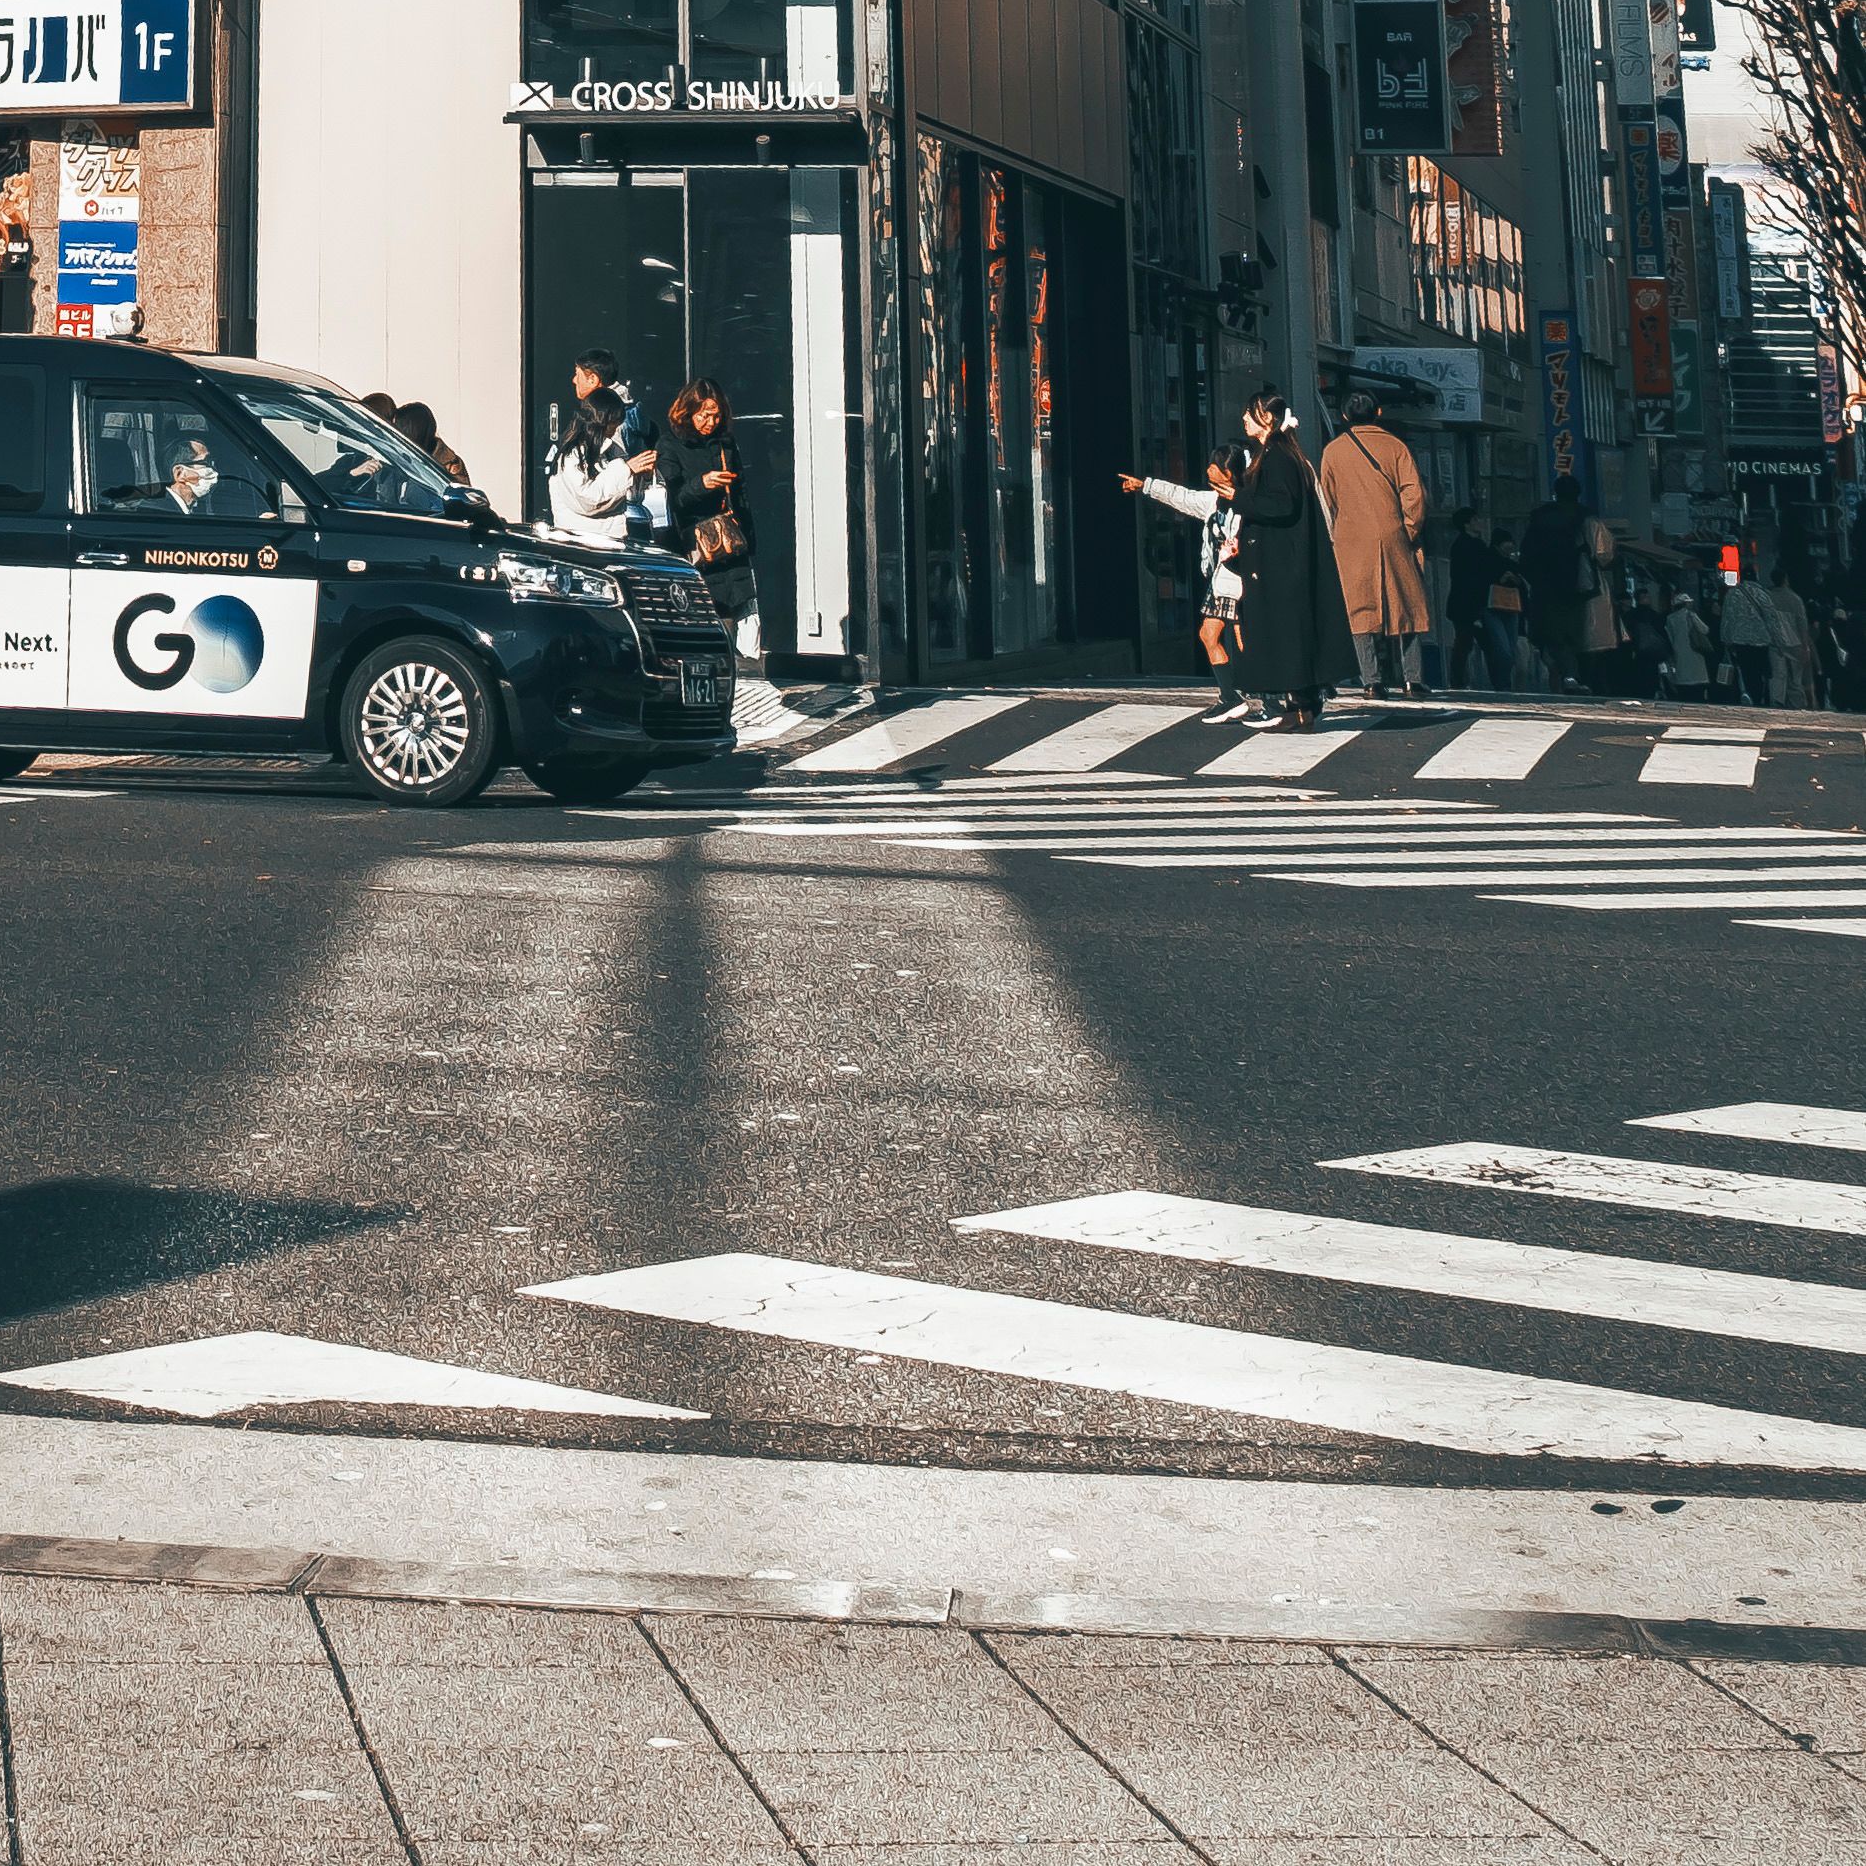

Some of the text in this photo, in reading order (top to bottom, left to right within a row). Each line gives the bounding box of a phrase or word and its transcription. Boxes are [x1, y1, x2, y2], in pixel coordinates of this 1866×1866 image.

[134, 22, 174, 72] 1F
[570, 81, 840, 112] CROSS SHINJUKU
[1545, 348, 1575, 477] マツモトキヨ
[1751, 461, 1822, 475] CINEMAS
[144, 549, 249, 569] NIHONKOTSU
[5, 631, 59, 653] Next.
